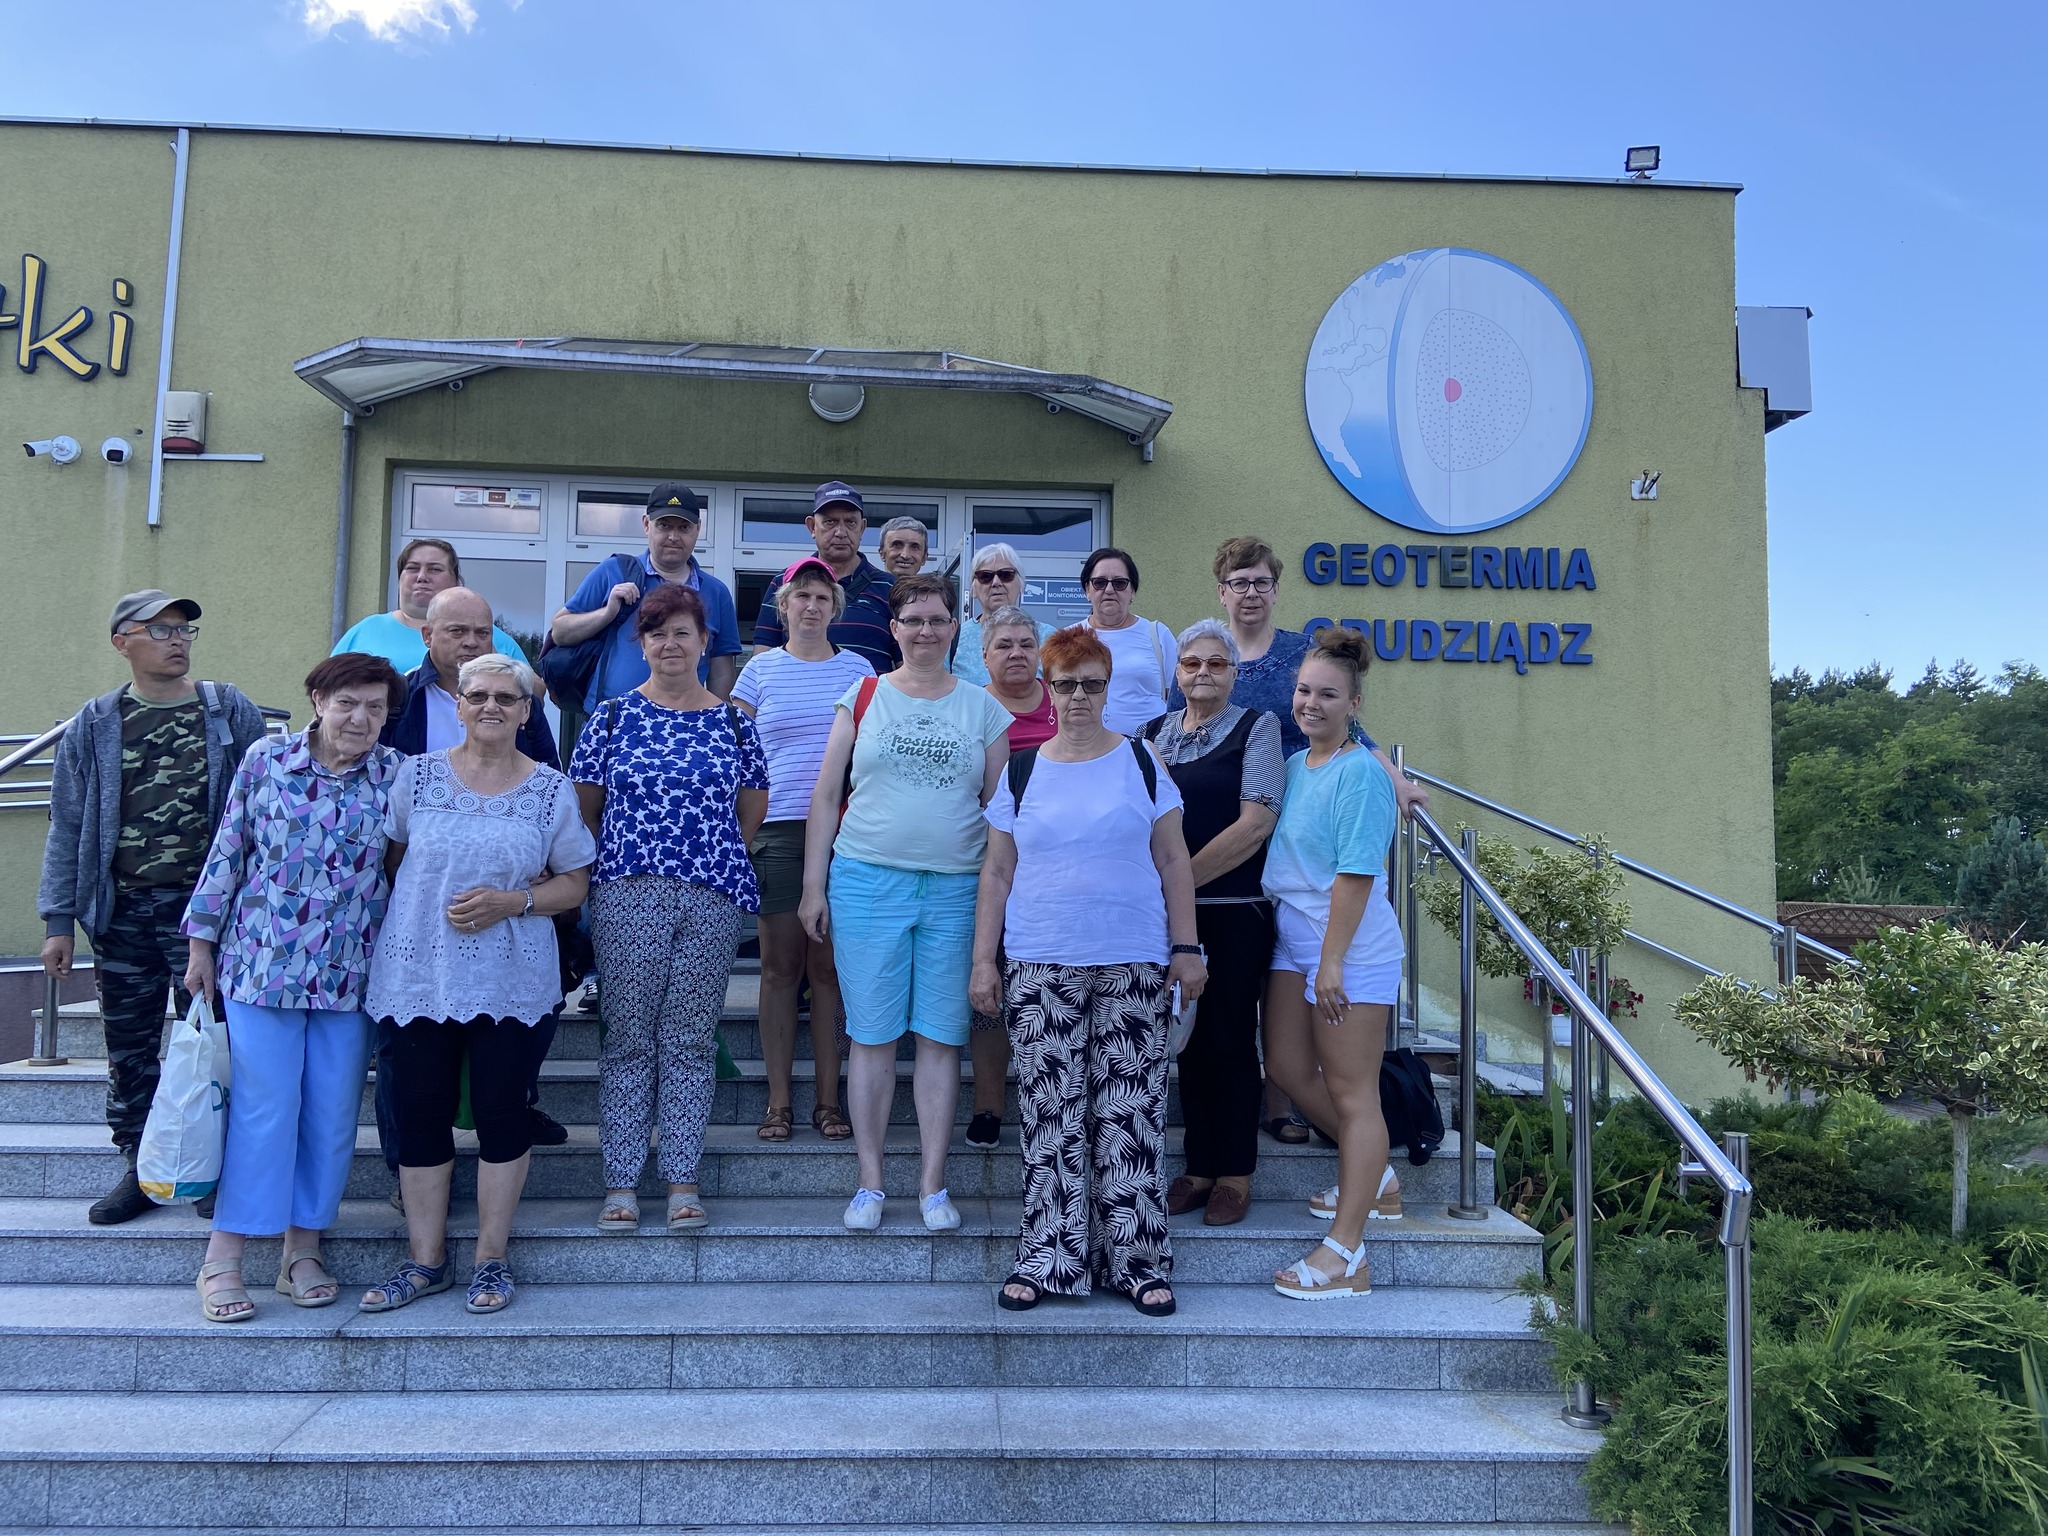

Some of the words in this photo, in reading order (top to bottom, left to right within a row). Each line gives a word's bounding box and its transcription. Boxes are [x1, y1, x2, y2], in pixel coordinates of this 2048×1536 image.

[1303, 542, 1597, 590] GEOTERMIA
[891, 734, 961, 750] positive
[896, 744, 954, 765] energy
